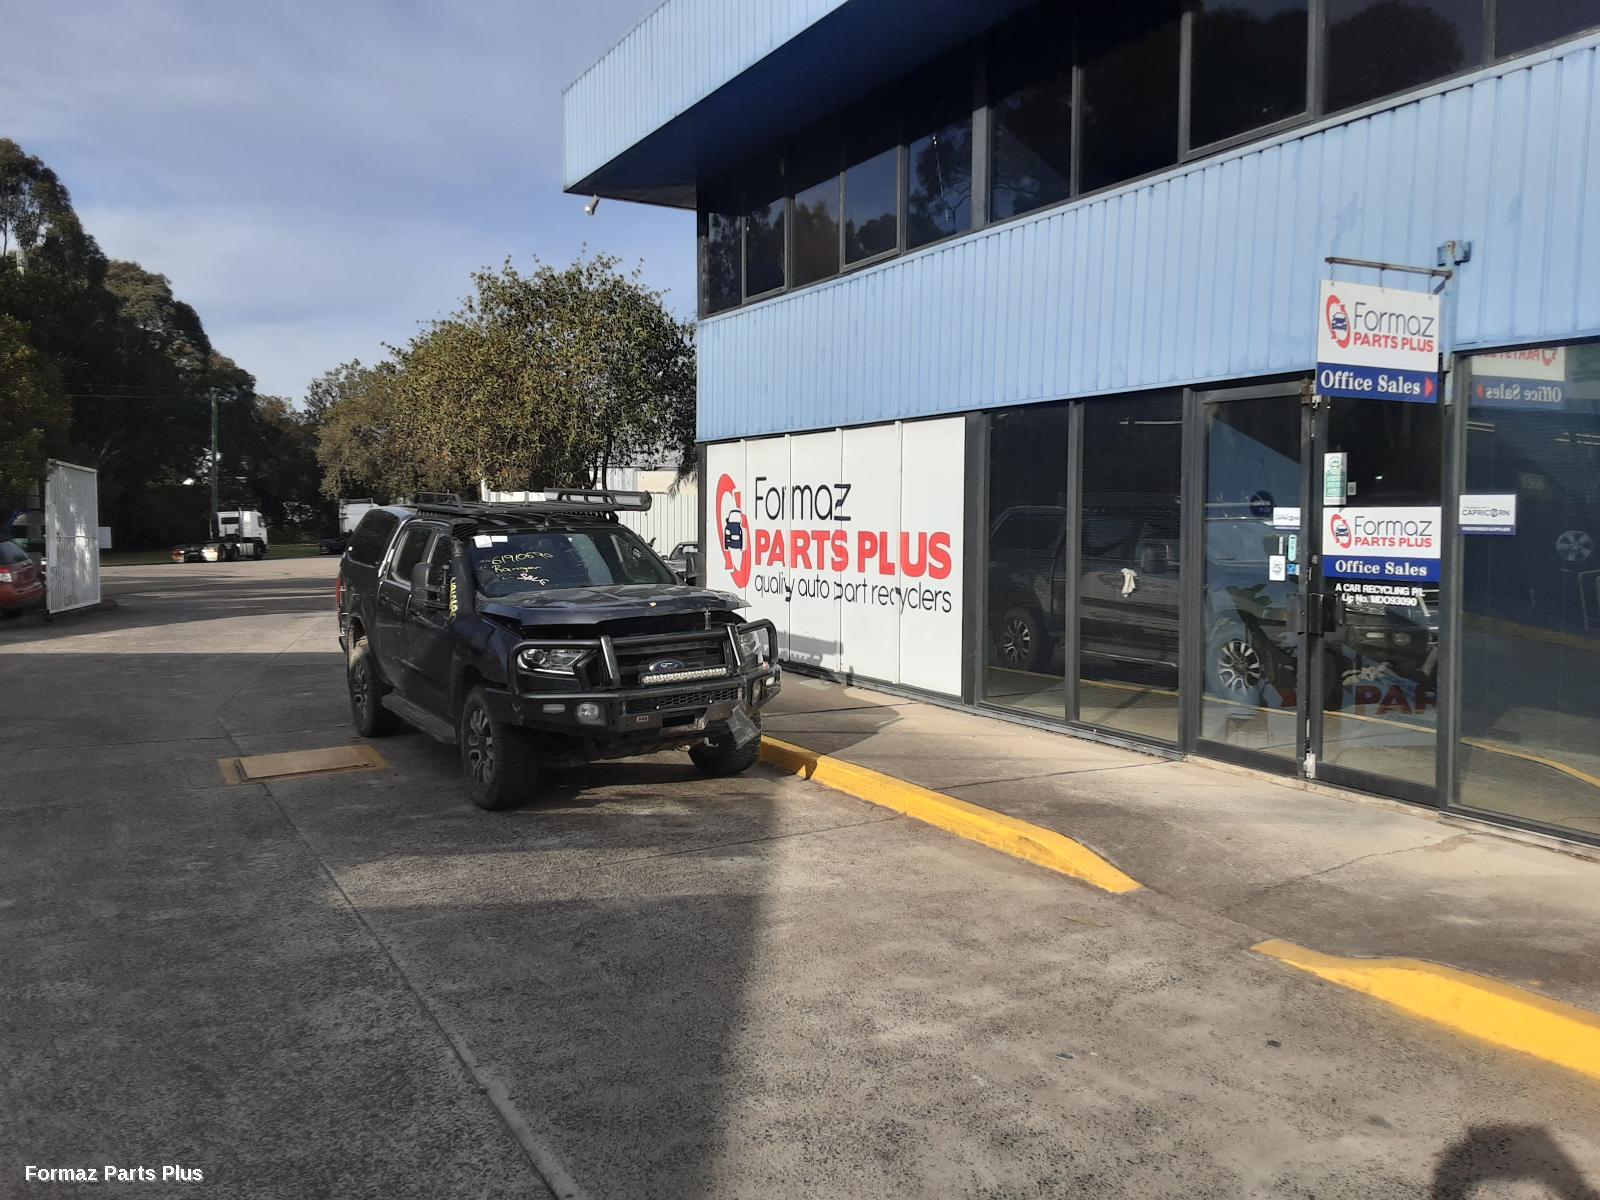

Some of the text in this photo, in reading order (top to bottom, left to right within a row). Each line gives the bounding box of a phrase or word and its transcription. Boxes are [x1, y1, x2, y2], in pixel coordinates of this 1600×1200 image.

[1354, 301, 1434, 338] Formaz
[1353, 331, 1434, 353] PARTS PLUS
[1320, 369, 1421, 395] Office Sales
[754, 476, 851, 521] Formaz
[1354, 515, 1433, 537] Formaz
[754, 528, 952, 580] PARTS PLUS
[1354, 536, 1433, 548] PARTS PLUS
[1335, 559, 1428, 577] Office Sales
[754, 571, 952, 615] qualiy auto part recyclers
[1335, 583, 1342, 592] A
[1343, 583, 1361, 593] CAR
[1362, 584, 1410, 596] RECYCLING
